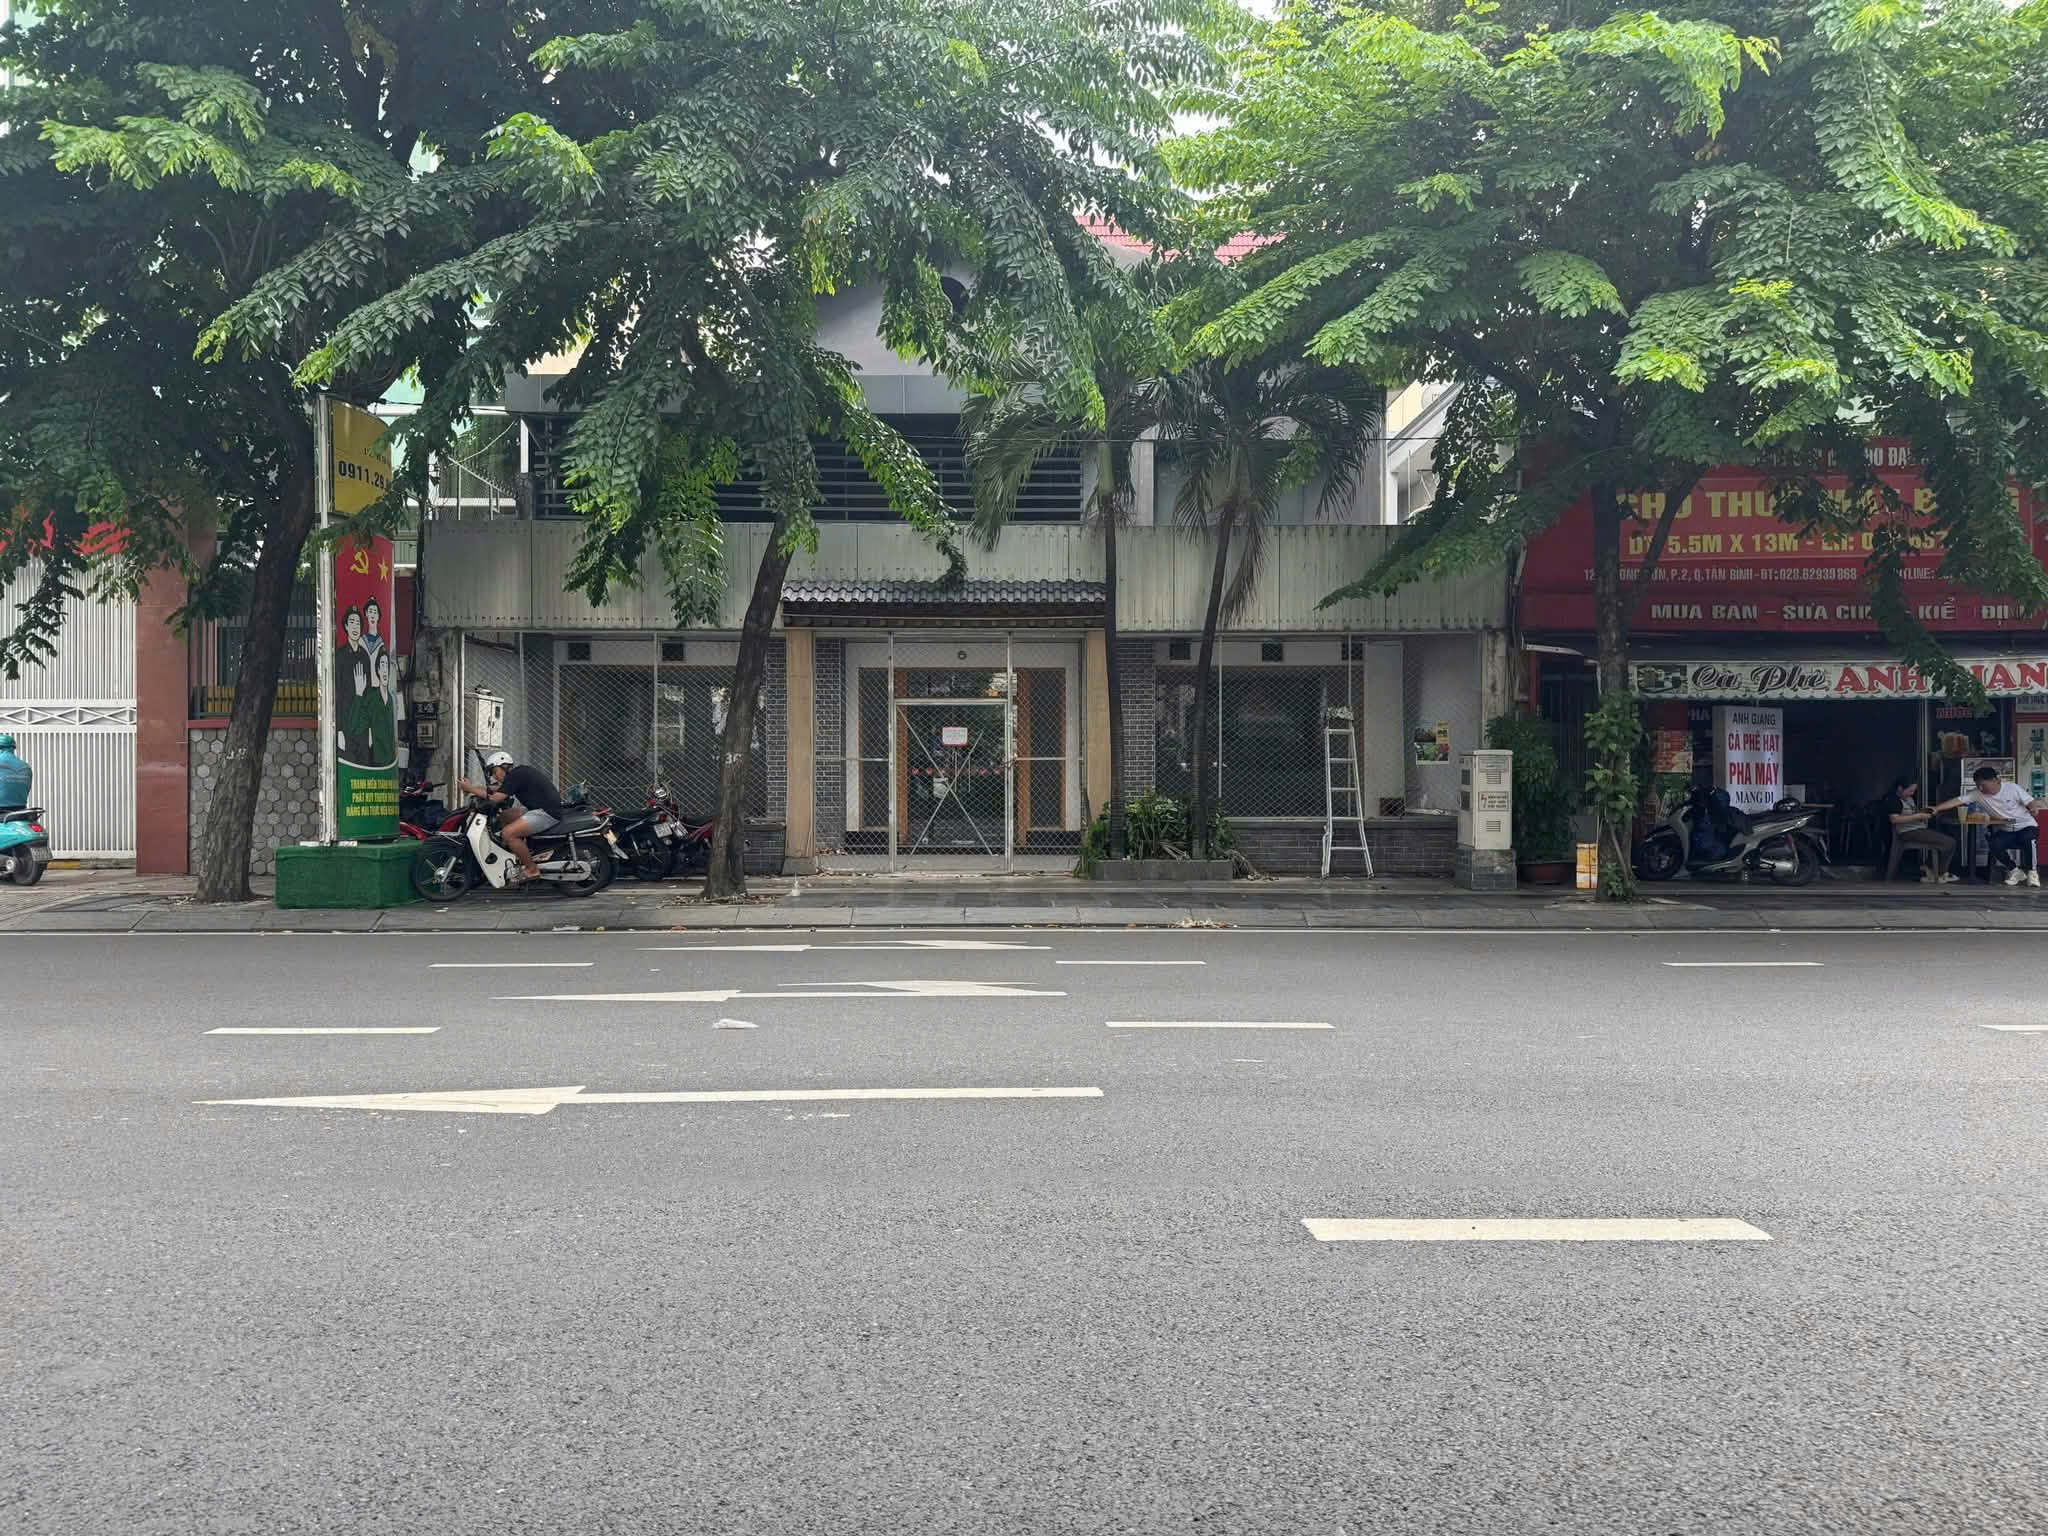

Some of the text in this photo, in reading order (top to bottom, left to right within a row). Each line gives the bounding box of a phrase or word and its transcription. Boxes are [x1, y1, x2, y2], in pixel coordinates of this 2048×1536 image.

[1668, 533, 1722, 555] 5.5M
[1729, 533, 1744, 553] X
[1752, 532, 1799, 552] 13M
[1651, 603, 1703, 620] MUA
[1833, 664, 1929, 694] ANH
[1732, 711, 1776, 726] ANH GIANG
[1729, 757, 1780, 785] PHA MÁY
[1735, 791, 1763, 804] MANG
